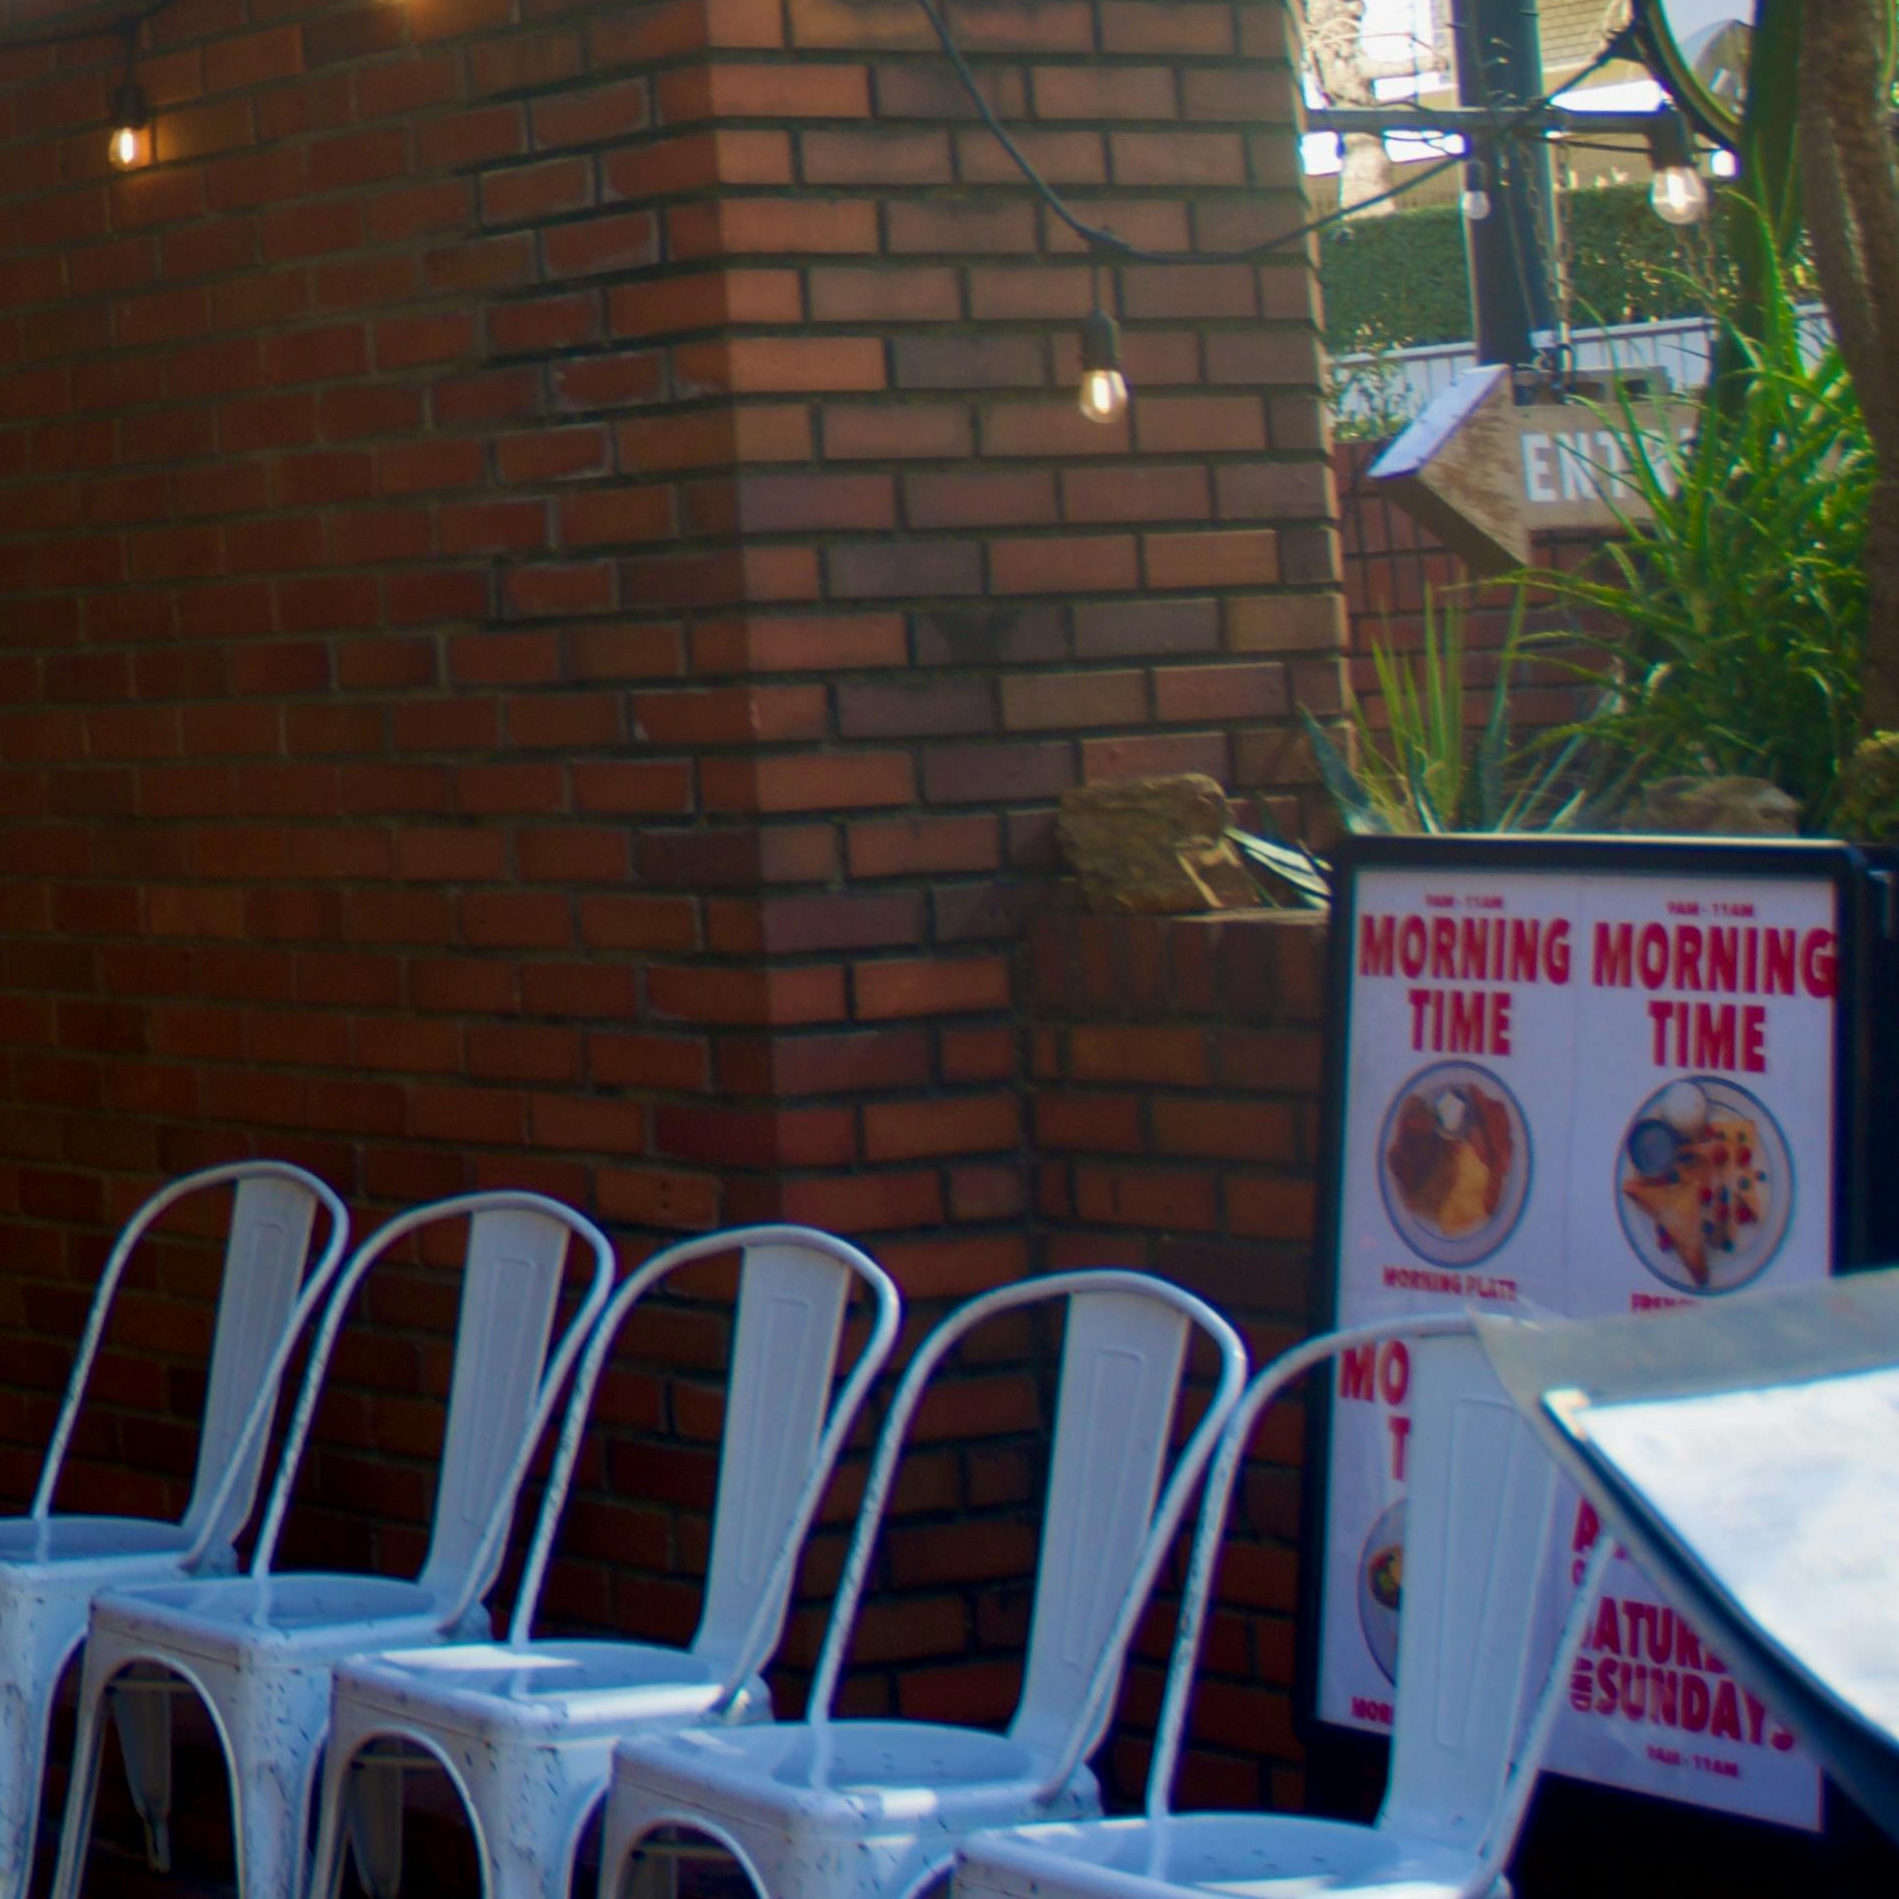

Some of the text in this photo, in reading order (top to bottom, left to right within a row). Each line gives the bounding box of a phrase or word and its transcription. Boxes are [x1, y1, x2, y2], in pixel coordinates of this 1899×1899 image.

[1359, 913, 1572, 986] MORNING
[1592, 921, 1838, 999] MORNING
[1407, 987, 1512, 1056] TIME
[1647, 999, 1767, 1074] TIME
[1381, 1265, 1518, 1302] MORNING PLATE
